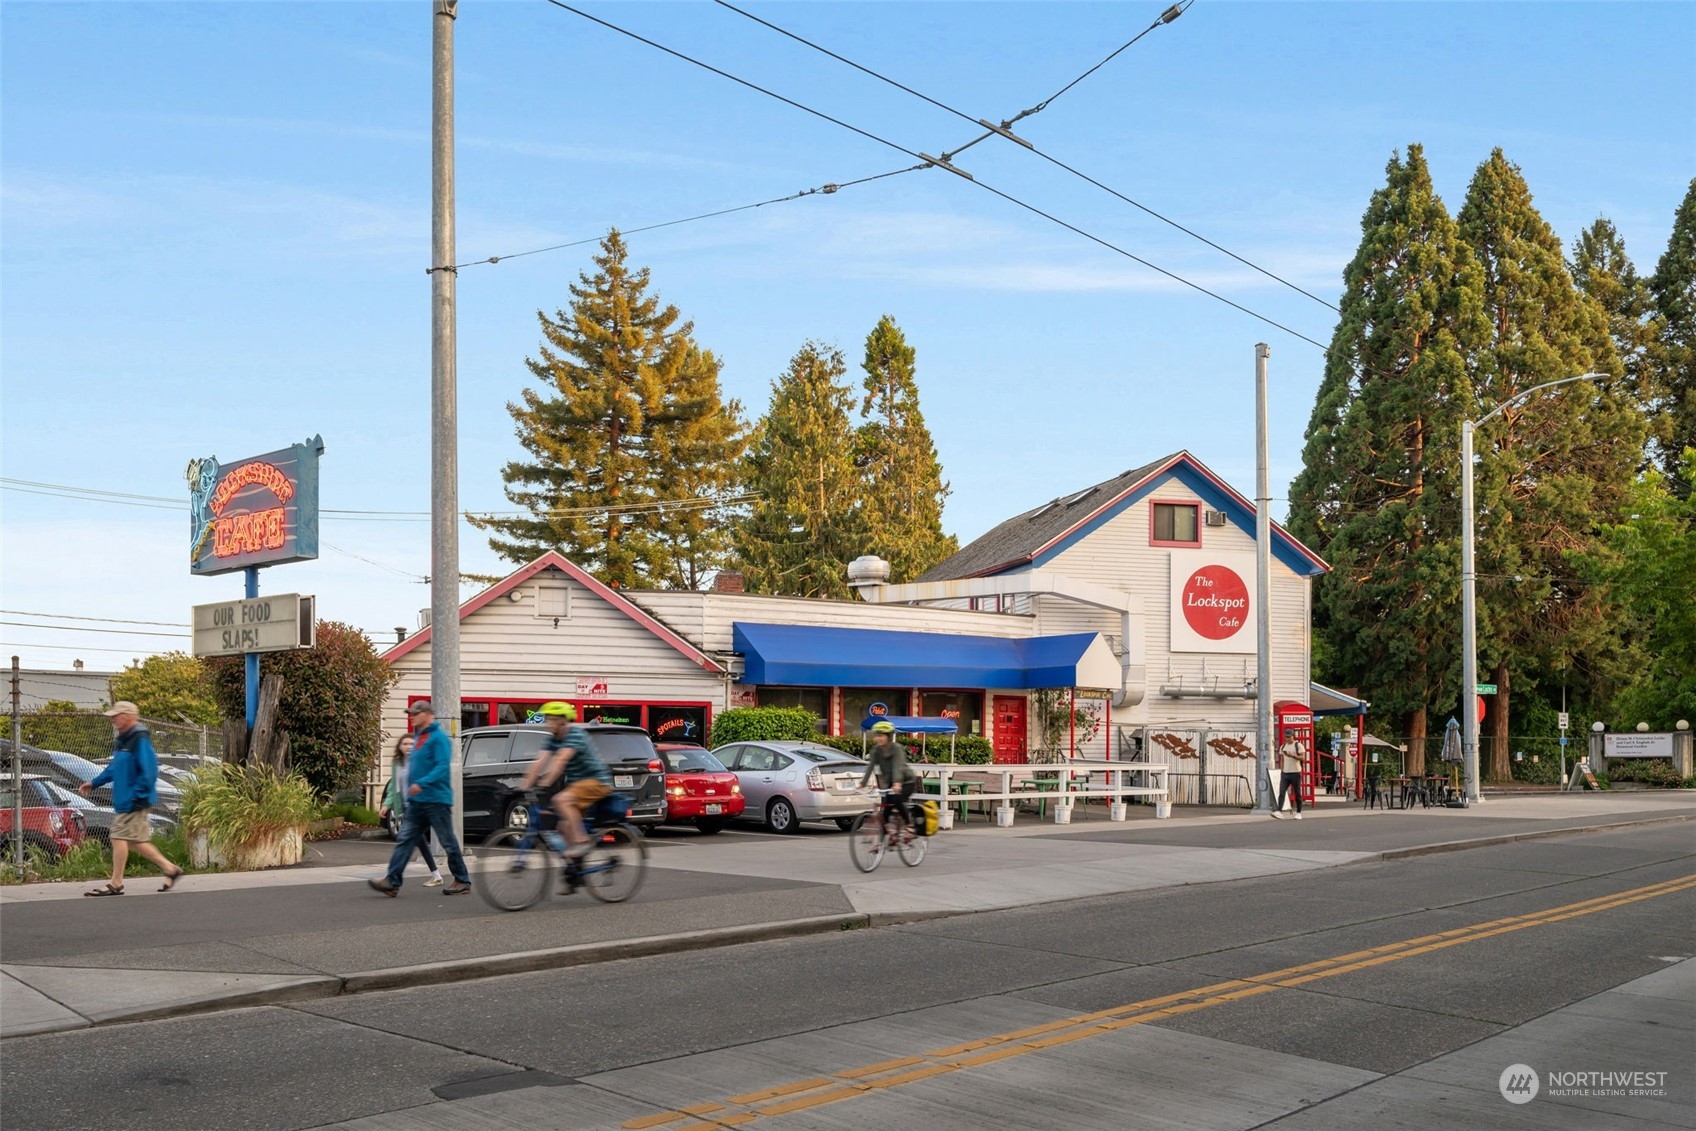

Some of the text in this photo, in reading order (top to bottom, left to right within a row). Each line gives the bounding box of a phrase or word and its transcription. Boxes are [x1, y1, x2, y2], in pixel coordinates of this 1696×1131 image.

[213, 507, 285, 558] CAFE
[1194, 576, 1214, 587] The
[1187, 592, 1246, 612] Lockspot
[213, 602, 271, 626] OUR FOOD
[1218, 616, 1240, 627] Cafe
[222, 628, 260, 650] SLAPS!
[941, 709, 960, 719] Open
[657, 719, 684, 735] SPOTAILS
